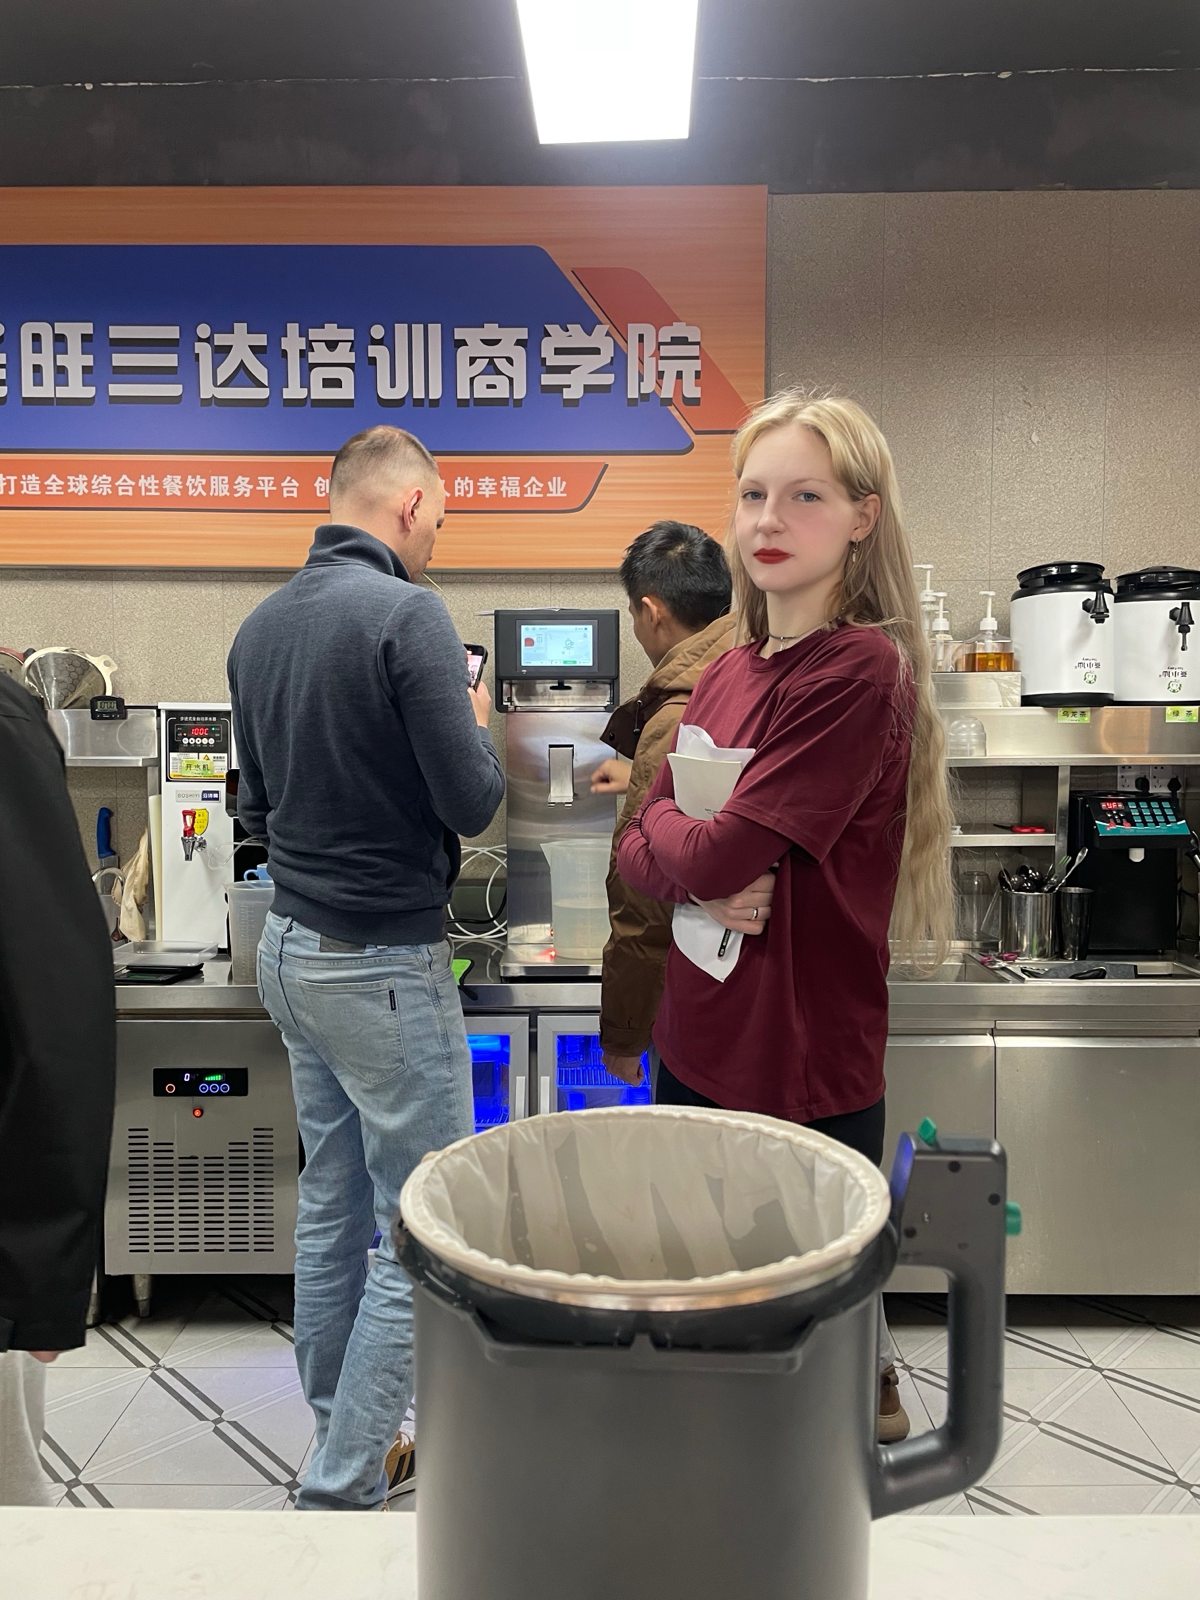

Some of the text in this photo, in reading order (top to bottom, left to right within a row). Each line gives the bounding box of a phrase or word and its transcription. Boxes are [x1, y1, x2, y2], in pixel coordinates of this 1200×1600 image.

[0, 321, 701, 398] 旺三达培训商学院
[0, 474, 300, 498] 打造全球综合性餐饮服务平台
[186, 763, 210, 771] 开水机
